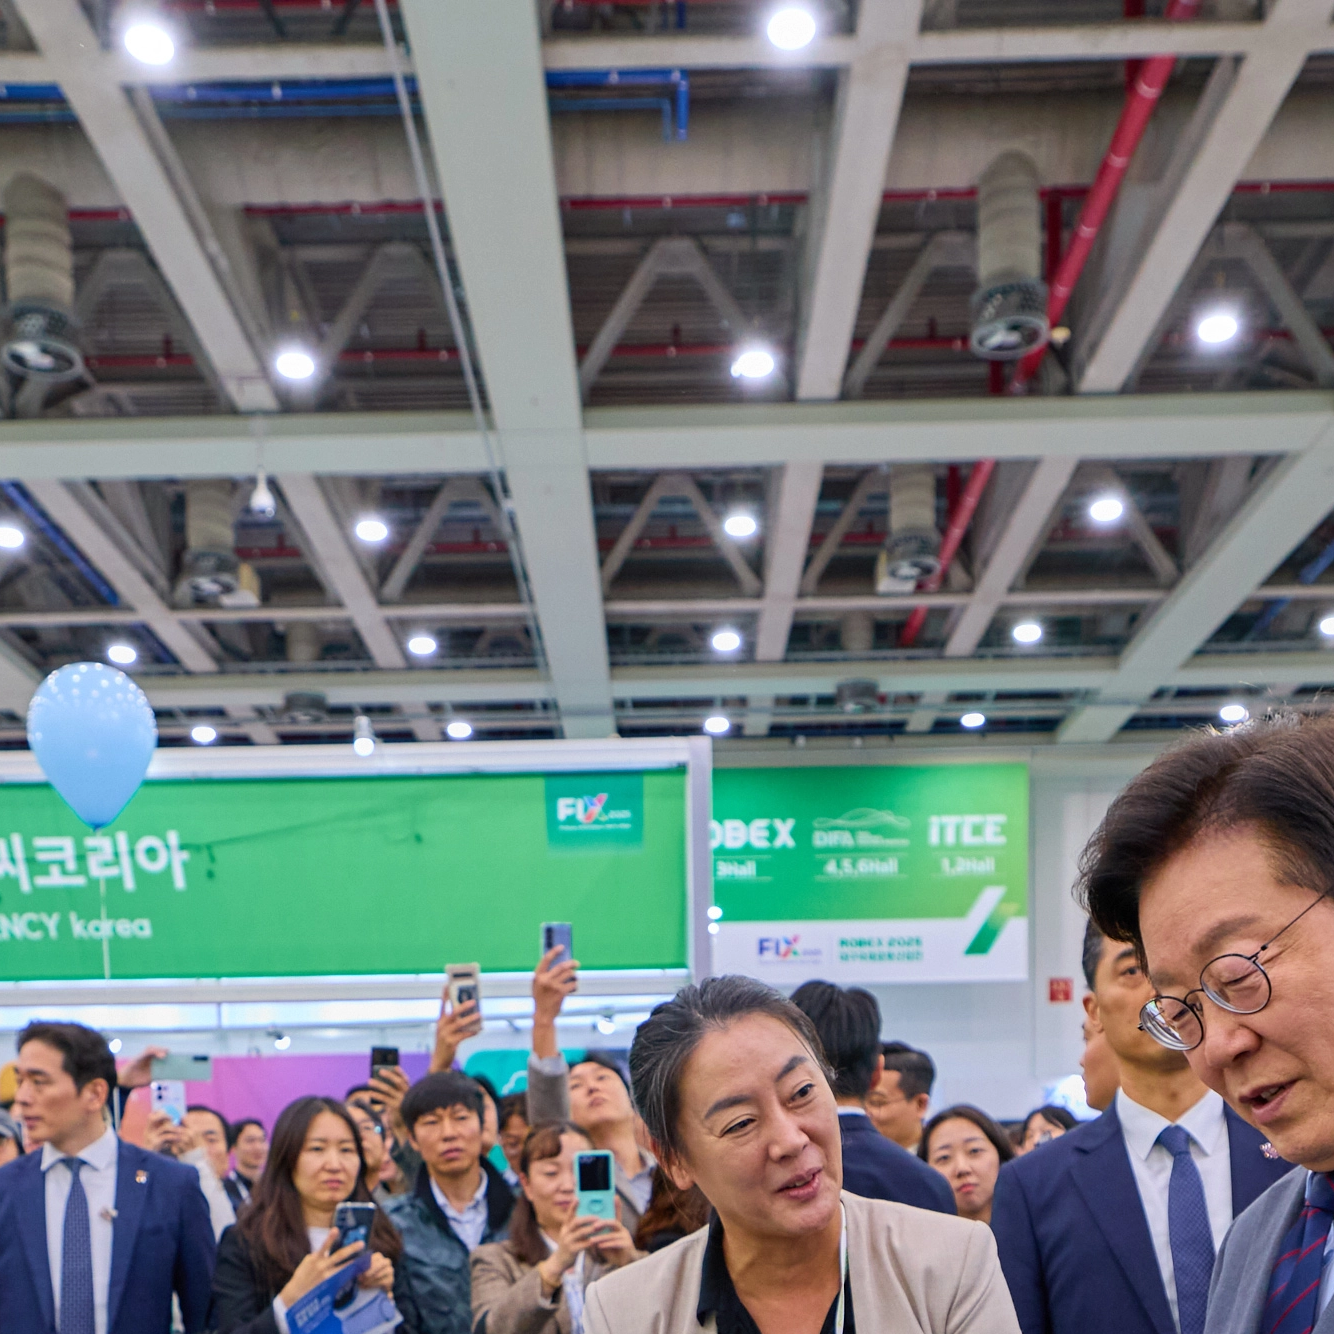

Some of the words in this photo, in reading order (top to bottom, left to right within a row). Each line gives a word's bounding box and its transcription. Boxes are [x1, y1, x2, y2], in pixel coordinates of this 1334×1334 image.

[557, 793, 608, 824] FIX
[70, 910, 153, 940] korea
[757, 935, 801, 959] FIX
